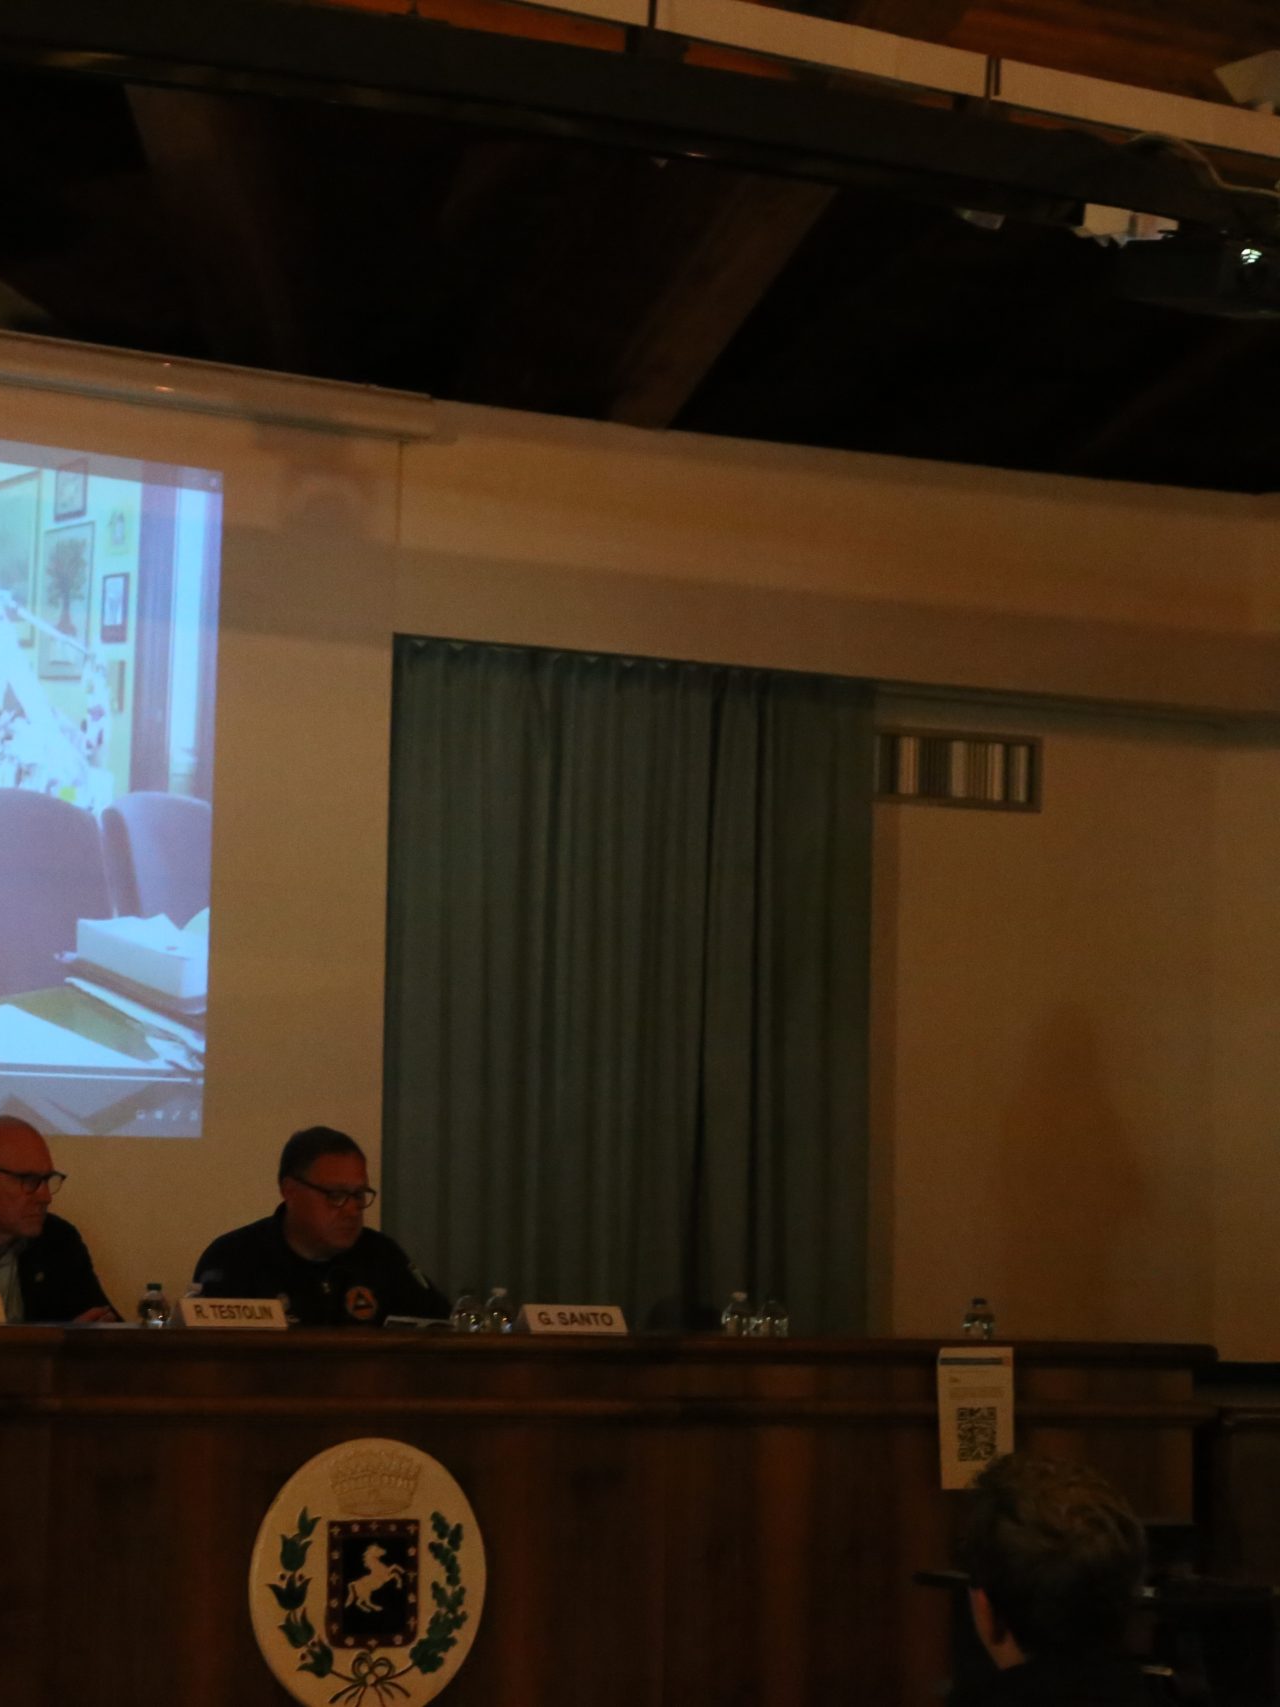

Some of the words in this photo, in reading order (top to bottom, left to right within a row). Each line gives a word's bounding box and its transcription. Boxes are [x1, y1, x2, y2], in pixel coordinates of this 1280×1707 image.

[192, 1304, 208, 1319] R.
[209, 1304, 274, 1320] TESTOLIN
[537, 1311, 554, 1326] G.
[556, 1311, 614, 1326] SANTO
